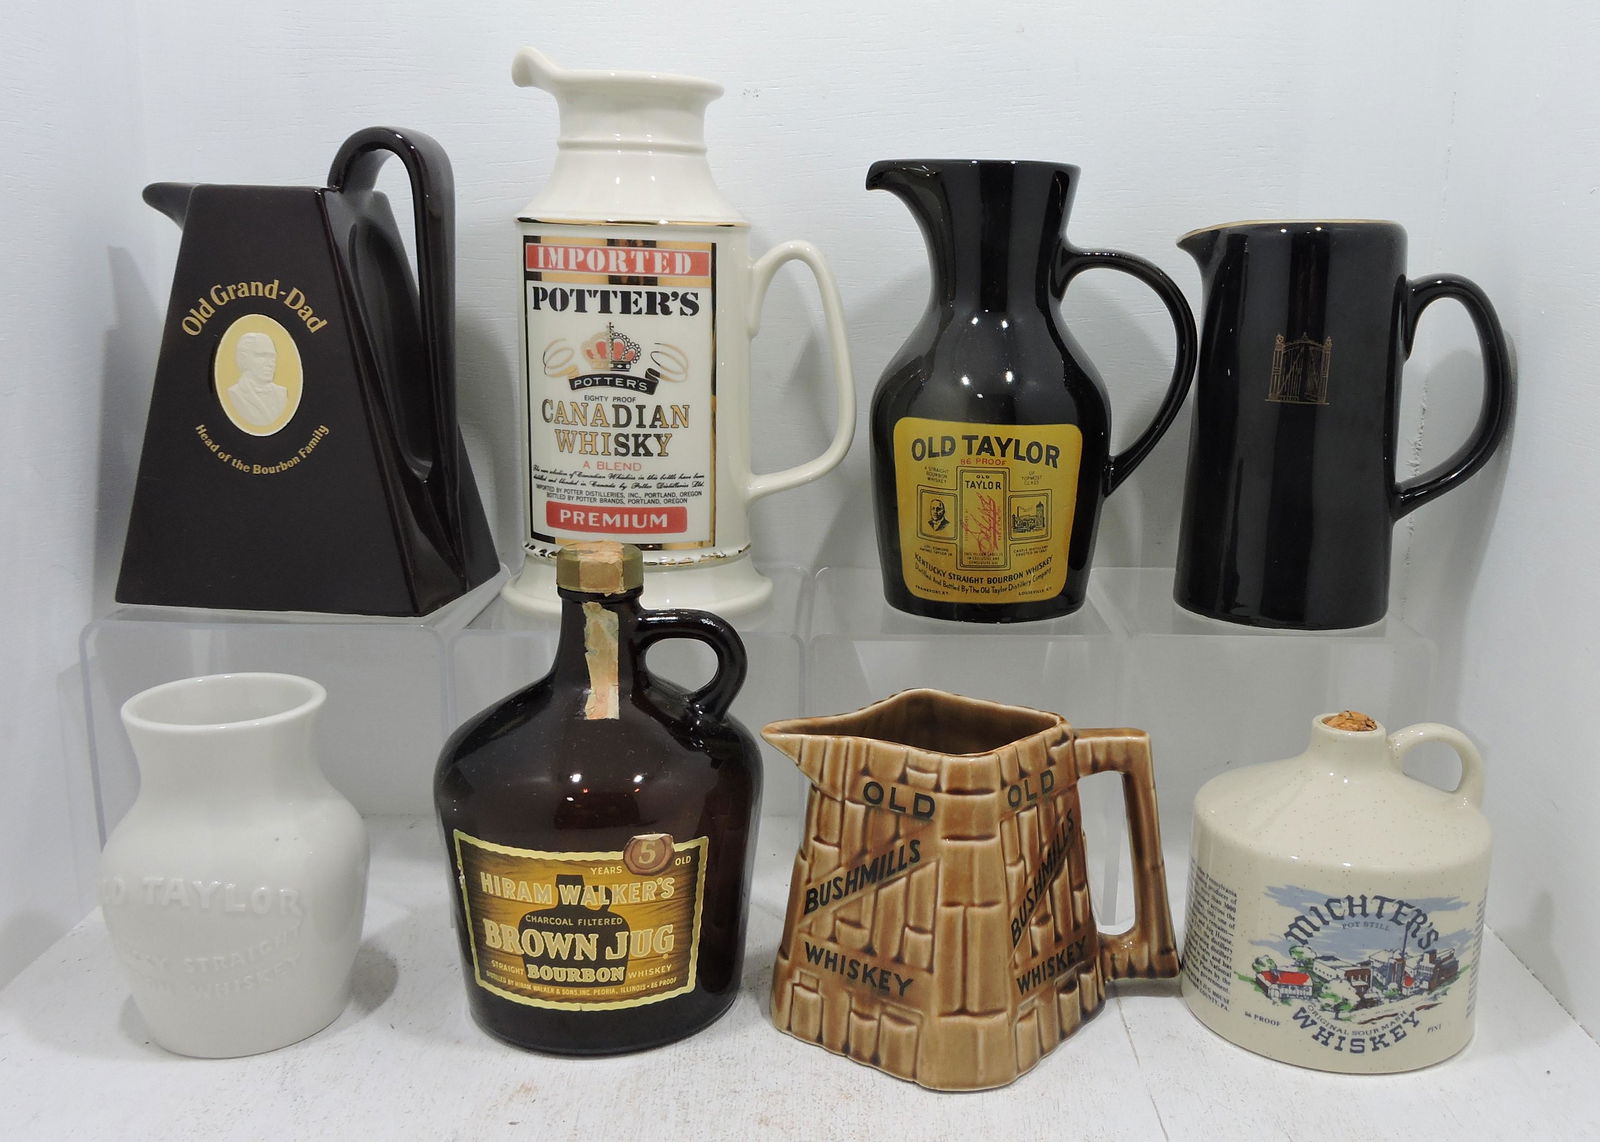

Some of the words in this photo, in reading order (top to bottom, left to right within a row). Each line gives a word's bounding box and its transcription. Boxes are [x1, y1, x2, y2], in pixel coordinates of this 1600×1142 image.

[537, 246, 692, 275] IMPORTED
[181, 298, 216, 337] Old
[210, 279, 328, 334] Grand-Dad
[532, 286, 700, 317] POTTER'S
[573, 377, 648, 392] POTTER'S
[541, 399, 690, 429] CANADIAN
[195, 424, 220, 453] Head
[218, 450, 232, 463] of
[232, 457, 250, 473] the
[252, 455, 301, 475] Bourbon
[298, 424, 330, 459] Family
[554, 429, 673, 457] WHISKY
[911, 436, 957, 462] OLD
[961, 435, 1060, 469] TAYLOR
[582, 460, 591, 469] A
[596, 461, 642, 472] BLEND
[975, 458, 1008, 466] PROOF
[564, 488, 584, 496] POTTER
[680, 490, 702, 498] OREGON
[964, 480, 1002, 490] TAYLOR
[576, 496, 597, 504] POTTER
[559, 508, 668, 529] PREMIUM
[915, 552, 947, 578] KENTUCKY
[948, 572, 984, 584] STRAIGHT
[987, 571, 1024, 584] BOURBON
[1026, 554, 1053, 576] WHISKEY
[961, 584, 968, 594] By
[969, 585, 980, 594] The
[980, 586, 990, 594] Old
[992, 586, 1008, 596] Taylor
[1008, 580, 1032, 591] Distillery
[863, 780, 936, 819] OLD
[1007, 769, 1055, 808] OLD
[590, 865, 623, 877] YEARS
[674, 855, 692, 866] OLD
[638, 840, 656, 865] 5
[480, 871, 553, 905] HIRAM
[558, 877, 675, 906] WALKER'S
[803, 839, 921, 916] BUSHMILLS
[1011, 808, 1075, 947] BUSHMILLS
[143, 876, 303, 916] TAYLOR
[525, 914, 574, 926] CHARCOAL
[578, 916, 624, 926] FILTERED
[1284, 894, 1439, 950] MICHTER'S
[1342, 921, 1361, 930] POT
[1363, 921, 1390, 932] STILL
[483, 919, 600, 961] BROWN
[605, 924, 675, 960] JUG
[491, 959, 525, 976] STRAIGHT
[526, 963, 625, 983] BOURBON
[628, 963, 672, 980] WHISKEY
[804, 941, 914, 998] WHISKEY
[1016, 935, 1087, 996] WHISKEY
[515, 981, 532, 990] HIRAM
[533, 985, 555, 994] WALKER
[620, 984, 646, 992] ILLINOIS
[658, 976, 677, 987] PROOF
[1254, 1014, 1281, 1027] PROOF
[1292, 1006, 1420, 1054] WHISKEY
[1307, 1004, 1350, 1036] ORIGINAL
[1352, 1028, 1380, 1036] SOUR
[1381, 1010, 1406, 1032] MASH
